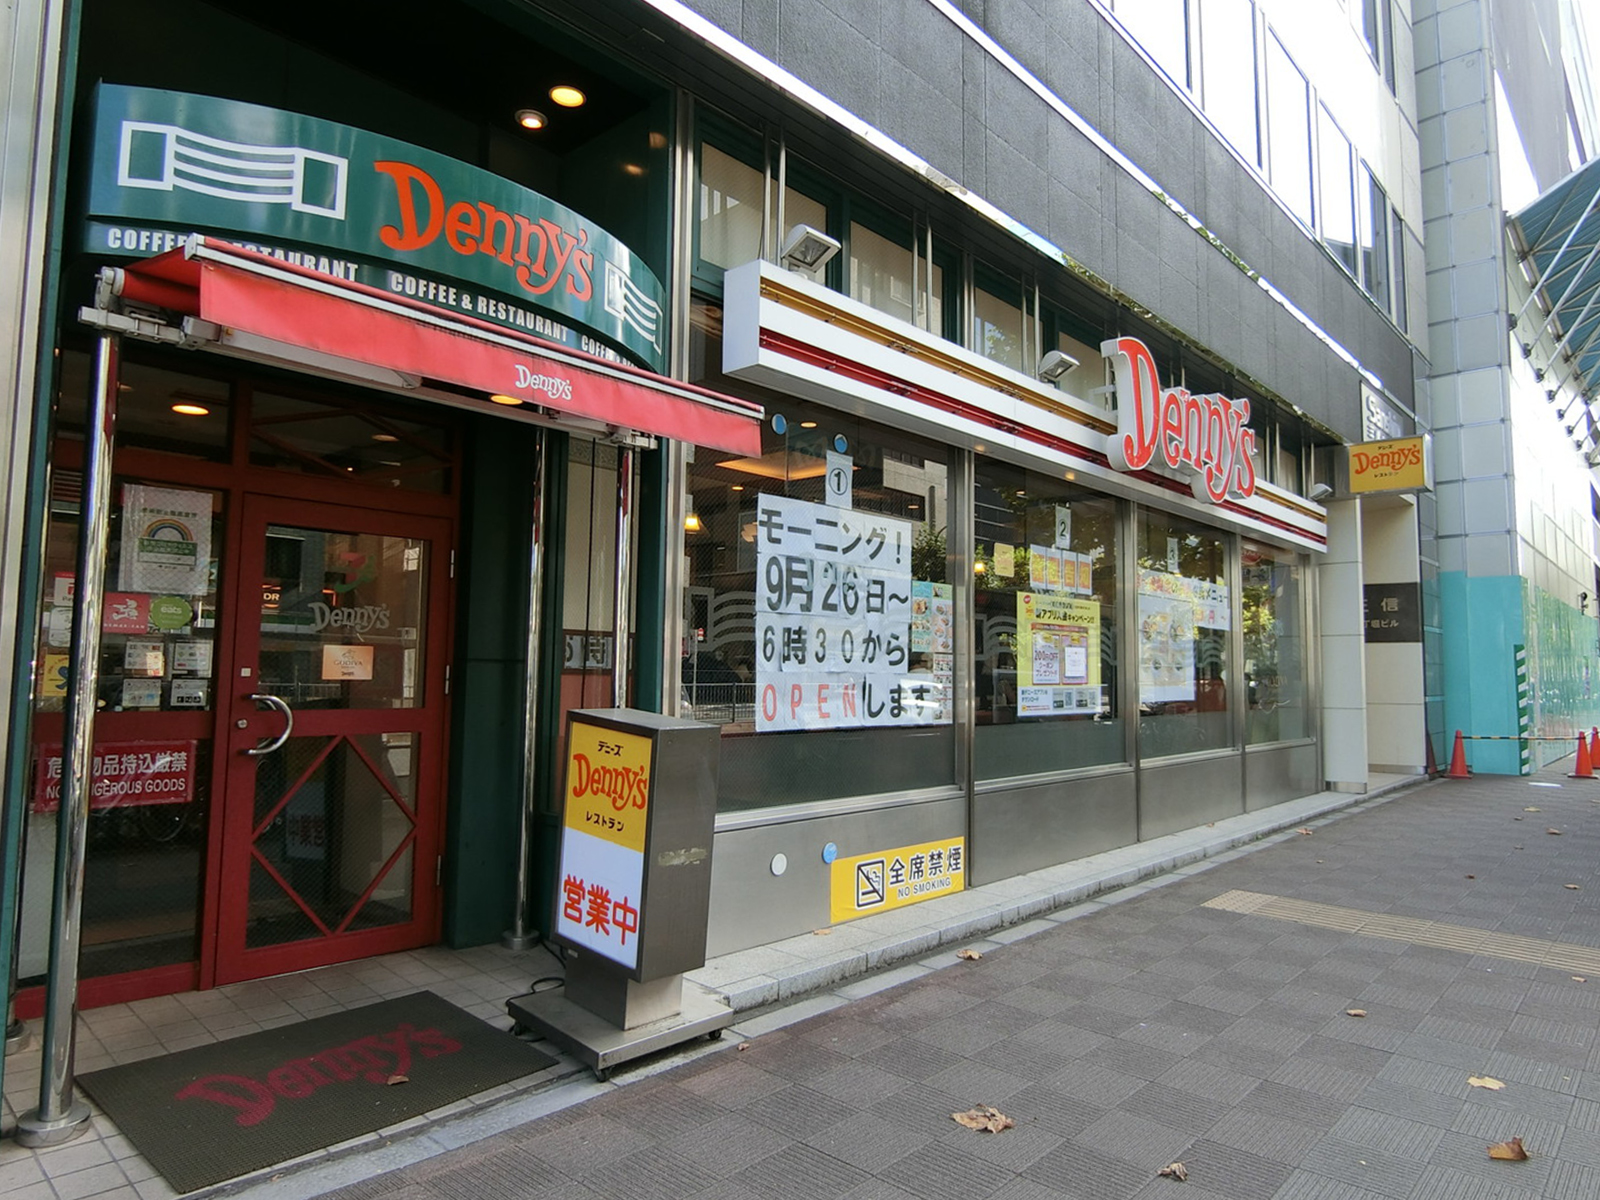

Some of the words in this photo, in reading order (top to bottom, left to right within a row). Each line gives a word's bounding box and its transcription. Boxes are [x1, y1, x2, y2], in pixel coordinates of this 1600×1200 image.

[107, 228, 185, 252] COFFEE
[374, 160, 594, 302] Denny's
[391, 272, 457, 307] COFFEE
[461, 293, 473, 311] &
[477, 295, 569, 343] RESTAURANT
[514, 364, 572, 401] Denny's
[1108, 336, 1256, 503] Denny's
[1352, 444, 1421, 475] Denny's
[759, 508, 903, 565] モーニング！
[307, 601, 391, 634] Denny's
[762, 625, 906, 667] 6時30から
[47, 750, 188, 779] 危物品持込厳禁
[598, 740, 624, 758] デニーズ
[145, 777, 186, 793] GOODS
[572, 753, 648, 811] Denny's
[586, 811, 625, 833] レストラン
[889, 846, 962, 886] 全席禁煙
[897, 886, 911, 898] NO
[913, 876, 952, 895] SMOKING
[563, 874, 639, 946] 営業中
[175, 1022, 463, 1127] Denny's
